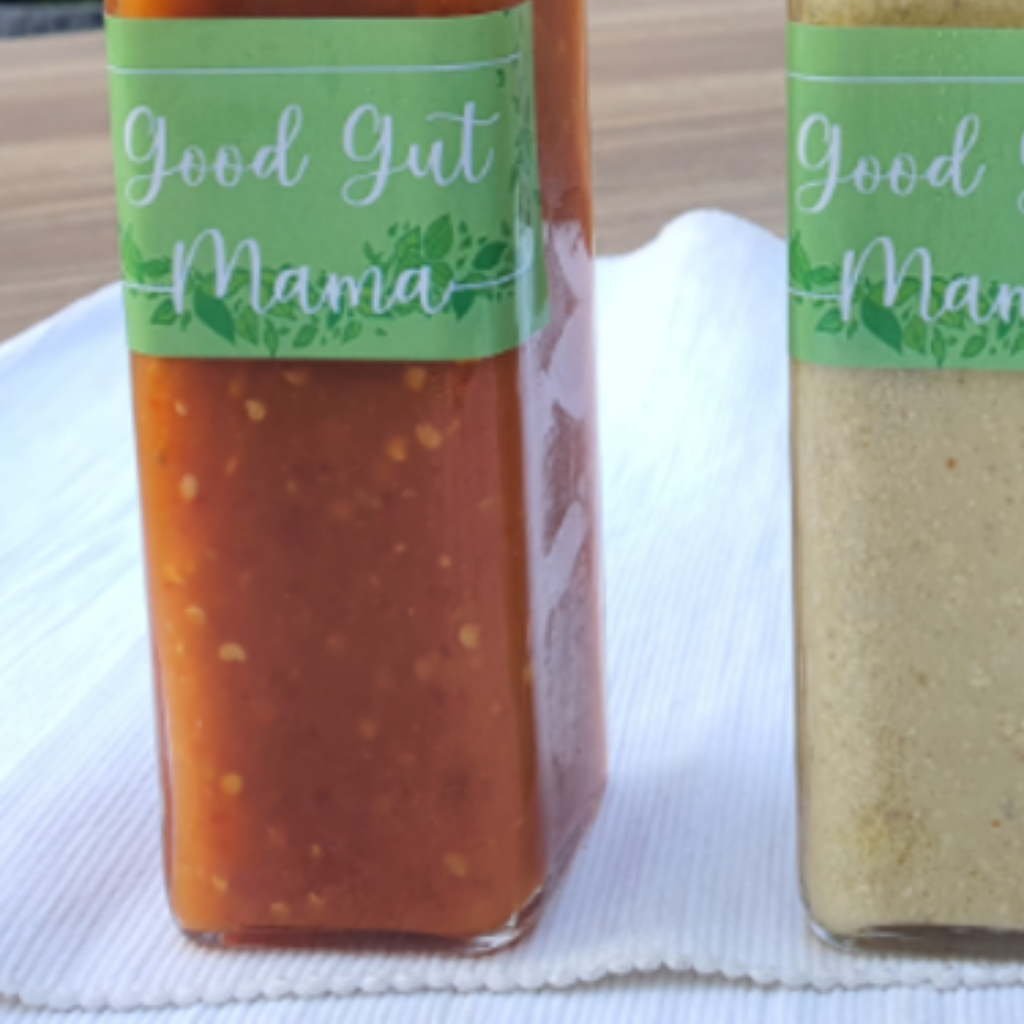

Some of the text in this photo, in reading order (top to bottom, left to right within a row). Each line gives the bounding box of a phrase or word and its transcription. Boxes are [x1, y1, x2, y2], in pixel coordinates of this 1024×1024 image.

[123, 100, 501, 207] Good Gut
[794, 112, 988, 215] Good
[171, 228, 457, 316] Mama
